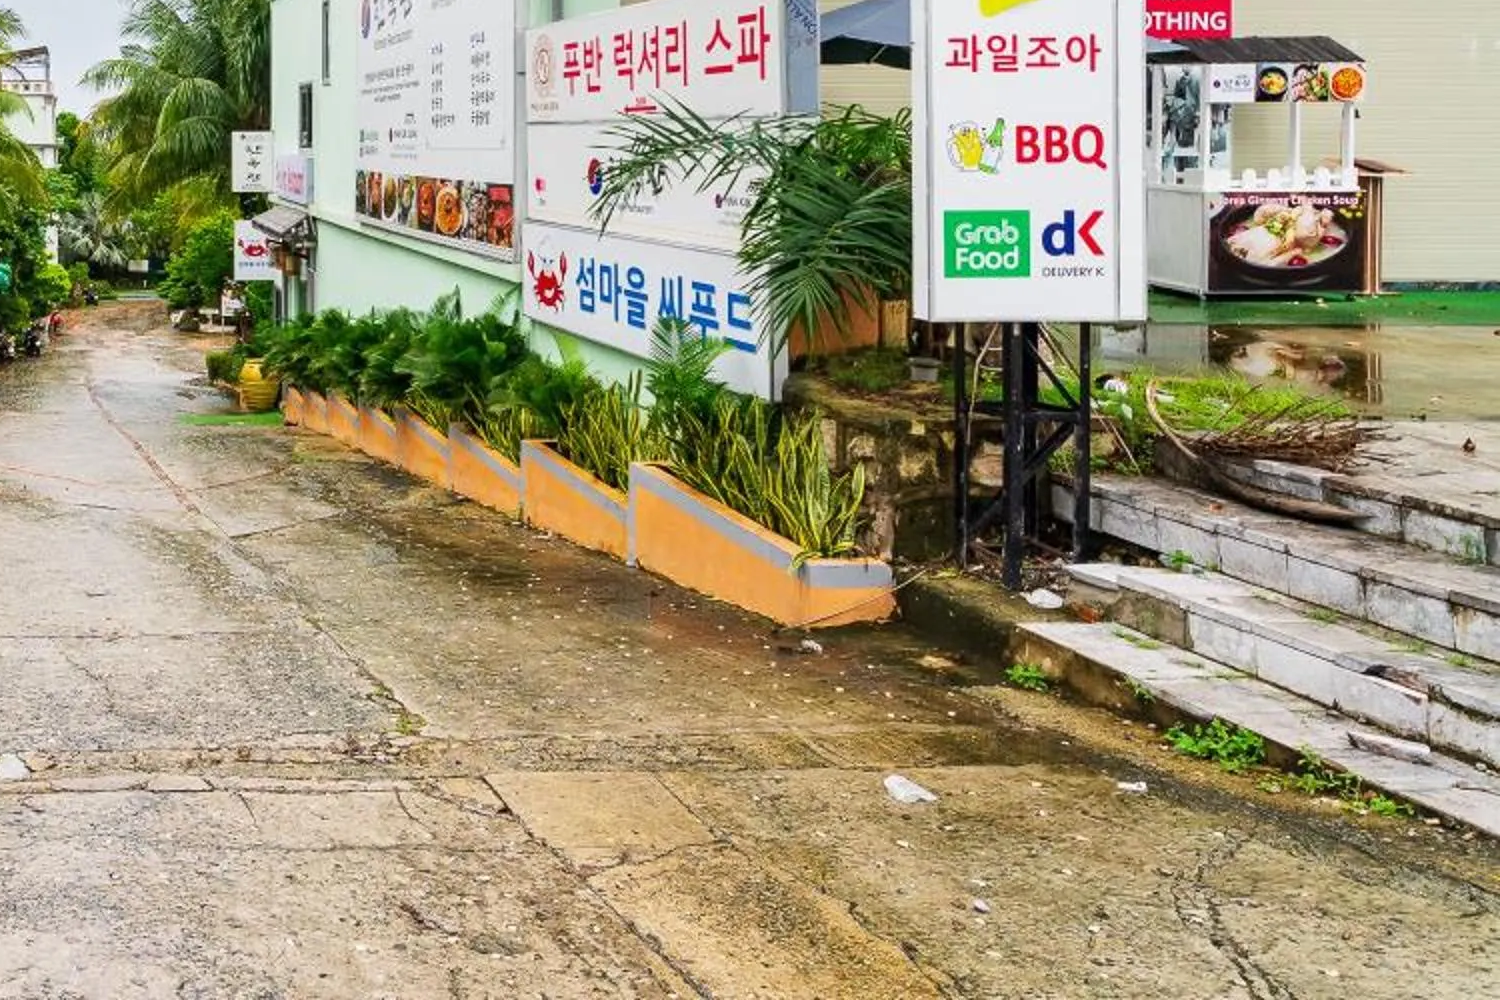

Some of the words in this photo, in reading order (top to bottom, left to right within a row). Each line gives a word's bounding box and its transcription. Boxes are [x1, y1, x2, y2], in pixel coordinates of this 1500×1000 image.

[1144, 10, 1227, 31] THING
[563, 36, 603, 96] 푸반
[613, 19, 689, 91] 럭셔리
[704, 6, 771, 81] 스파
[945, 34, 1102, 73] 과일조아
[1015, 124, 1107, 170] BBQ
[1332, 195, 1358, 206] Soup
[955, 219, 1020, 245] Grab
[955, 246, 1019, 270] Food
[1042, 267, 1093, 277] DELIVERY
[1095, 267, 1105, 277] K
[576, 257, 649, 330] 섬마을
[658, 275, 758, 354] 씨푸드
